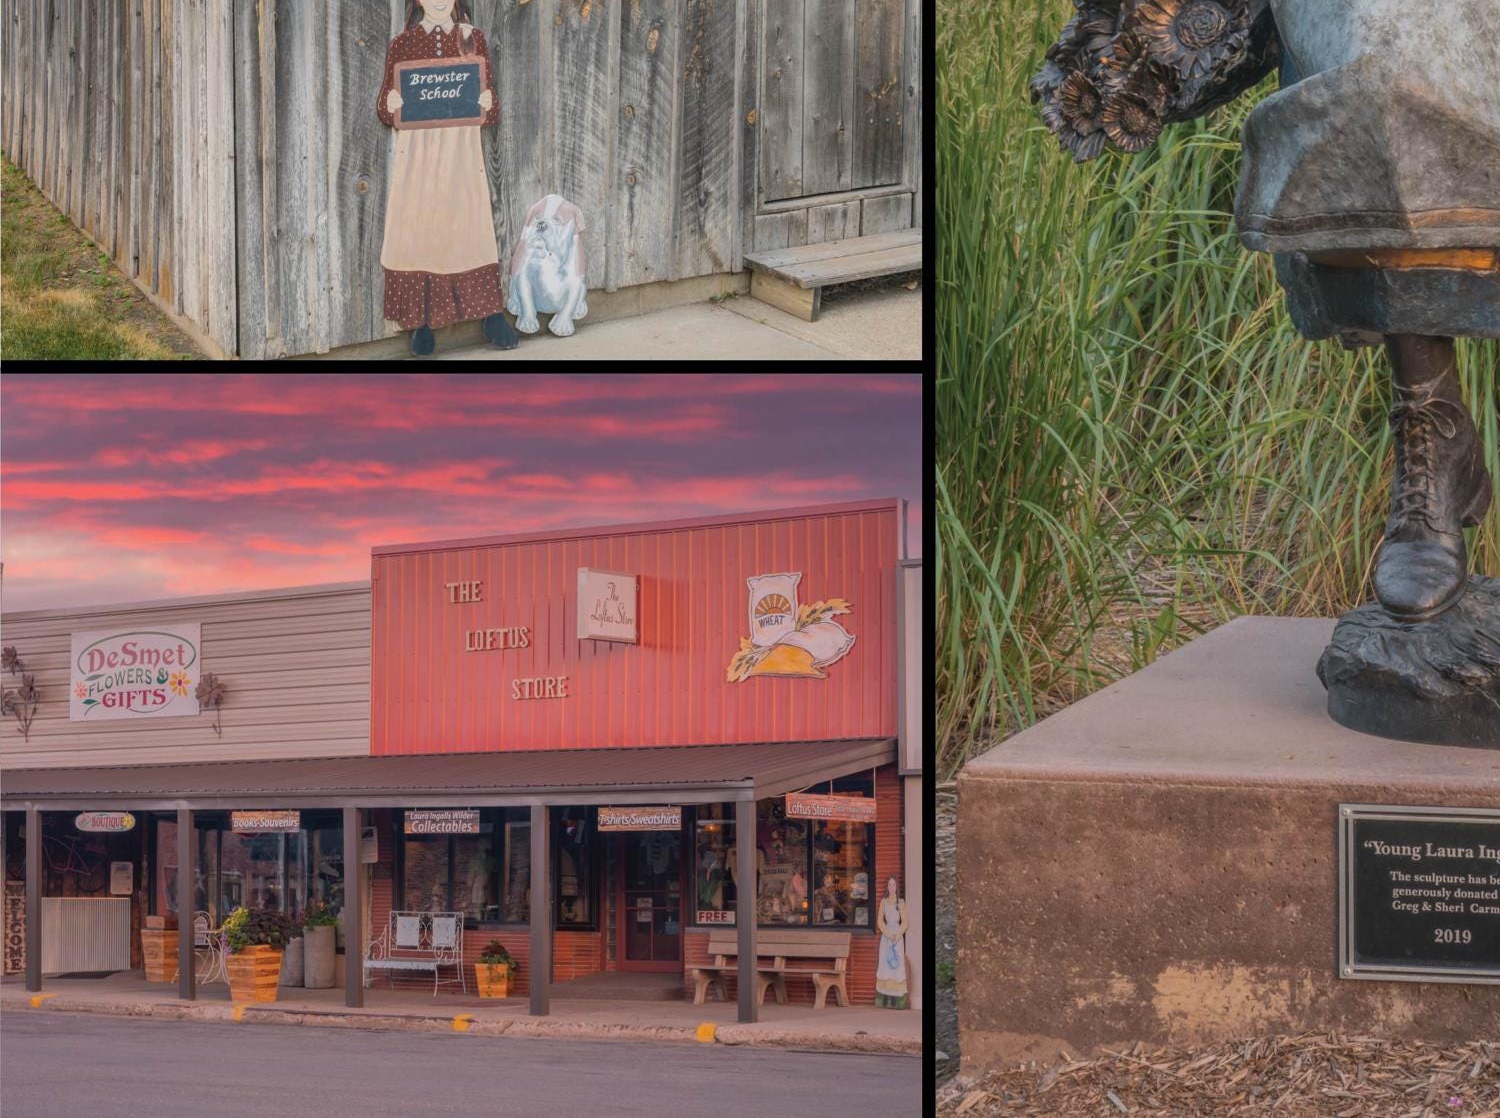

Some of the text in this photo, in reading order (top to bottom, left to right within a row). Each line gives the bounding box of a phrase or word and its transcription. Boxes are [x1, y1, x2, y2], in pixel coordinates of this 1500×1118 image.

[409, 71, 470, 86] Brewster
[420, 84, 463, 100] School
[446, 581, 482, 603] THE
[605, 582, 619, 602] The
[590, 599, 634, 627] Loftus Store
[759, 615, 786, 628] WHEAT
[465, 626, 530, 651] LOFTUS
[86, 642, 185, 673] DeSmet
[89, 667, 169, 697] FLOWERS &
[512, 676, 568, 700] STORE
[102, 688, 166, 709] GIFTS
[410, 811, 473, 821] Laura Ingalls Wilder
[788, 802, 811, 814] Loftus
[813, 803, 832, 816] Store
[92, 817, 126, 828] BOUTIQUE
[411, 820, 472, 833] Collectables
[1363, 840, 1422, 861] "Young
[1425, 842, 1474, 859] Laura
[1390, 870, 1411, 882] The
[1414, 872, 1465, 885] sculpture
[1468, 873, 1487, 884] has
[1392, 888, 1451, 900] generously
[1454, 888, 1498, 900] donated
[1392, 900, 1419, 914] Greg
[1422, 902, 1432, 912] &
[1435, 902, 1464, 913] Sheri
[699, 912, 727, 923] FREE
[1434, 929, 1472, 944] 2019
